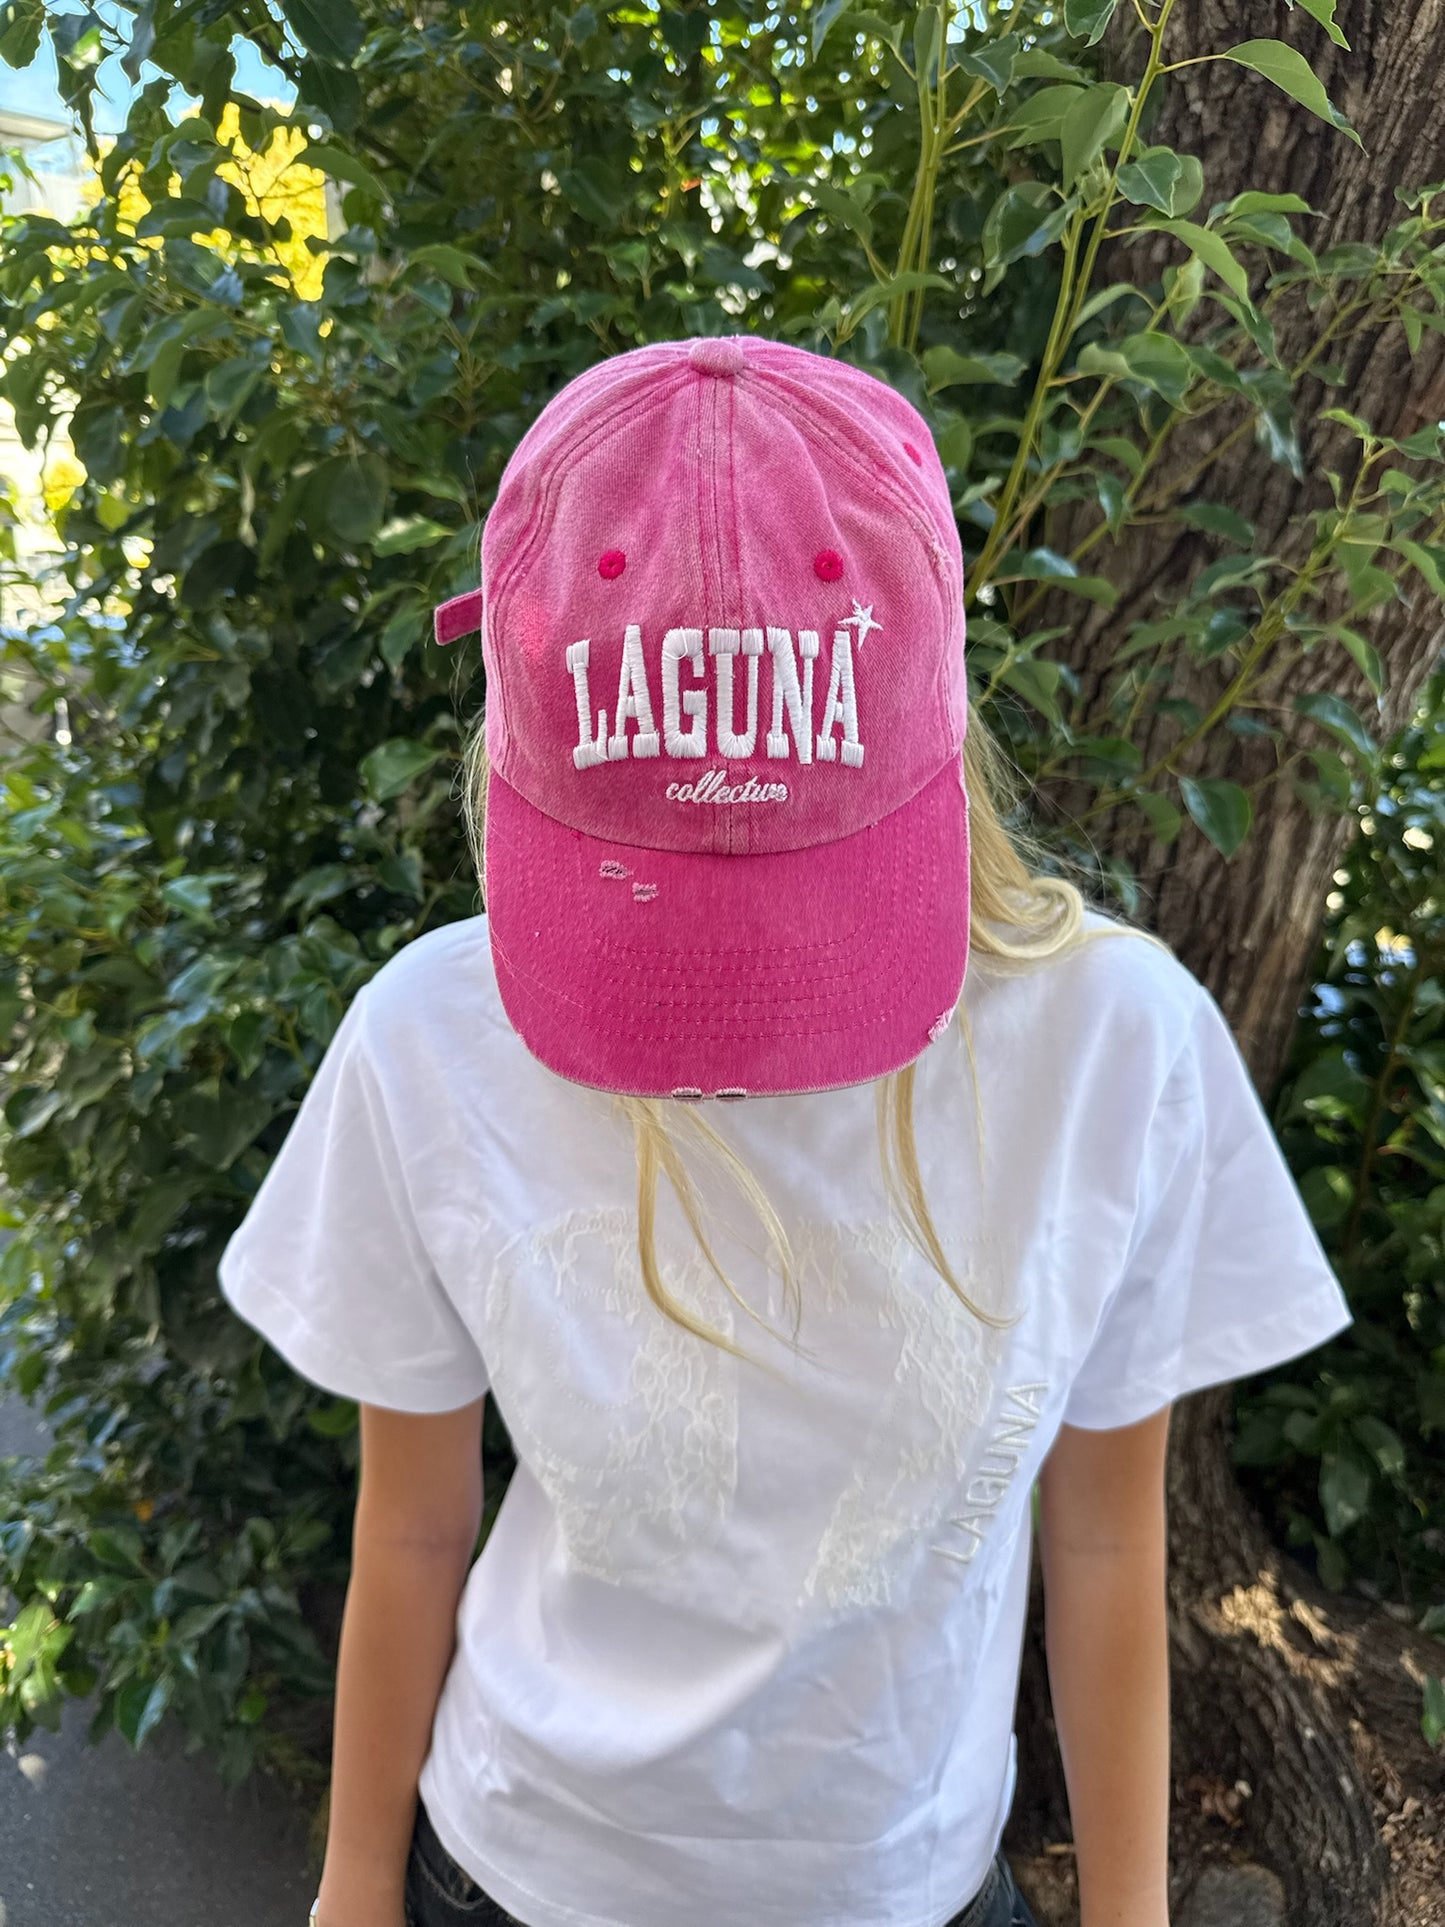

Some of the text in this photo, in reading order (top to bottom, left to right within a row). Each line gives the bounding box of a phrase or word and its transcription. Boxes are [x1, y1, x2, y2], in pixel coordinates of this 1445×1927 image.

[565, 624, 864, 769] LAGUNA
[665, 769, 788, 804] collective
[931, 1381, 1050, 1564] LAGUNA
